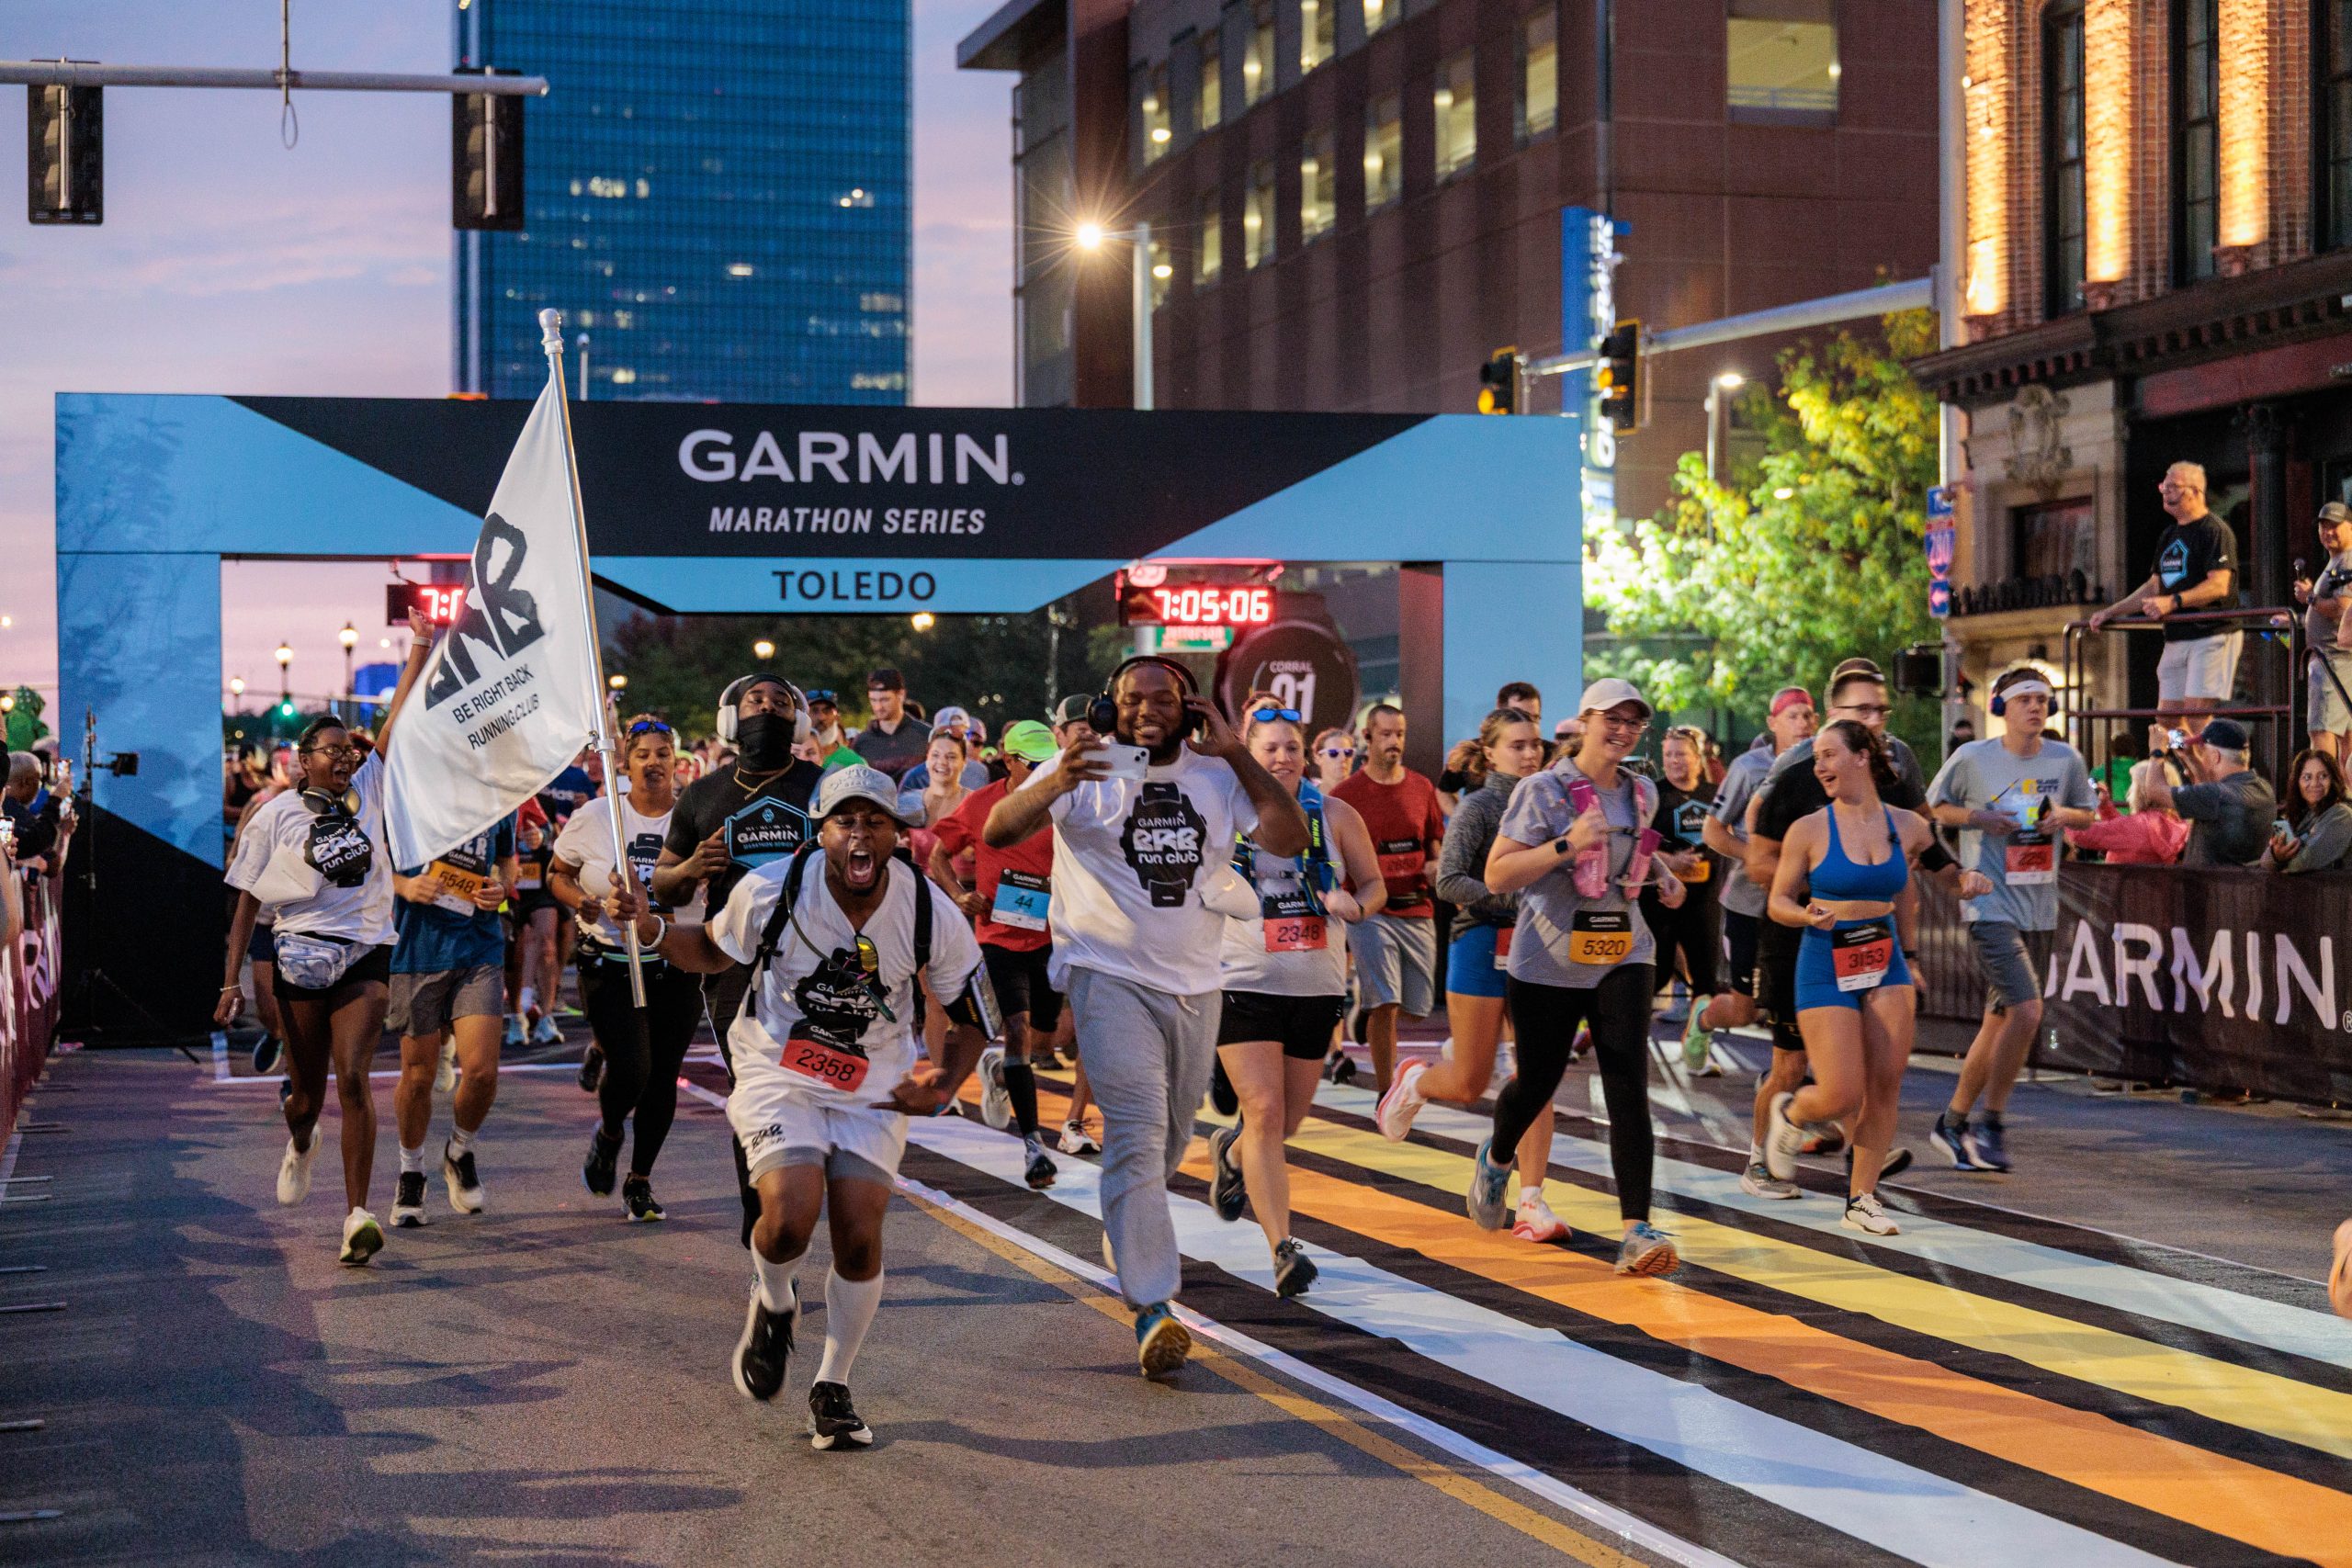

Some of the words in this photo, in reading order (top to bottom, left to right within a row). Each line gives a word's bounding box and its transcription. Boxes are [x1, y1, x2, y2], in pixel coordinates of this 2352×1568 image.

[709, 507, 873, 534] MARATHON
[882, 509, 987, 535] SERIES
[772, 570, 936, 602] TOLEDO
[1269, 660, 1314, 673] CORRAL
[452, 703, 475, 724] BE
[473, 681, 510, 715] RIGHT
[505, 663, 535, 692] BACK
[1270, 671, 1317, 725] 01
[468, 708, 517, 750] RUNNING
[514, 693, 540, 723] CLUB
[1137, 814, 1186, 827] GARMIN
[737, 829, 799, 844] GARMIN
[1132, 827, 1199, 852] BRB
[322, 856, 345, 873] run
[344, 843, 369, 861] club
[448, 850, 477, 866] GARMIN
[1138, 852, 1163, 864] run
[1165, 850, 1199, 864] club
[439, 870, 476, 895] 5548
[1012, 874, 1042, 885] GARMIN
[1014, 895, 1035, 909] 44
[1277, 924, 1321, 943] 2348
[1583, 940, 1626, 956] 5320
[1849, 948, 1884, 969] 3153
[796, 1048, 856, 1082] 2358
